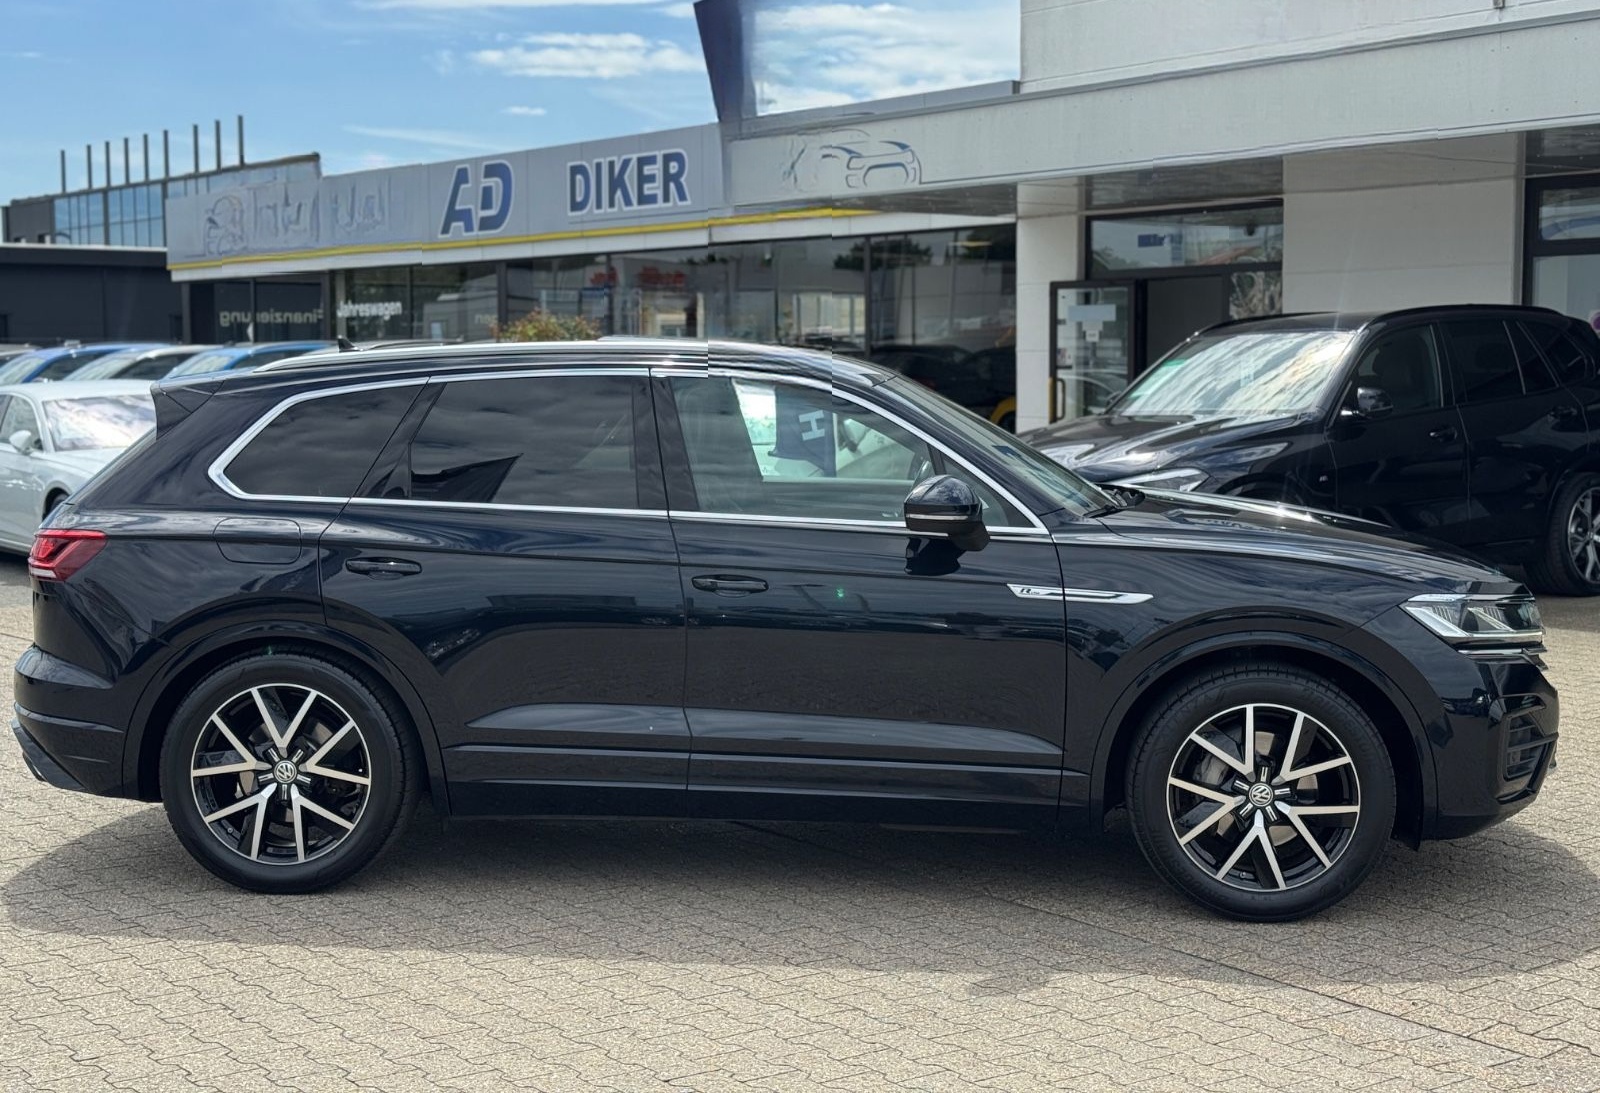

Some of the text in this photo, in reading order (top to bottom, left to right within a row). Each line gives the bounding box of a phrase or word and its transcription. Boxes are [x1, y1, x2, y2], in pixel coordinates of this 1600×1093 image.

[439, 159, 513, 238] AD
[568, 149, 691, 216] DIKER
[337, 300, 402, 320] Jahreswagen
